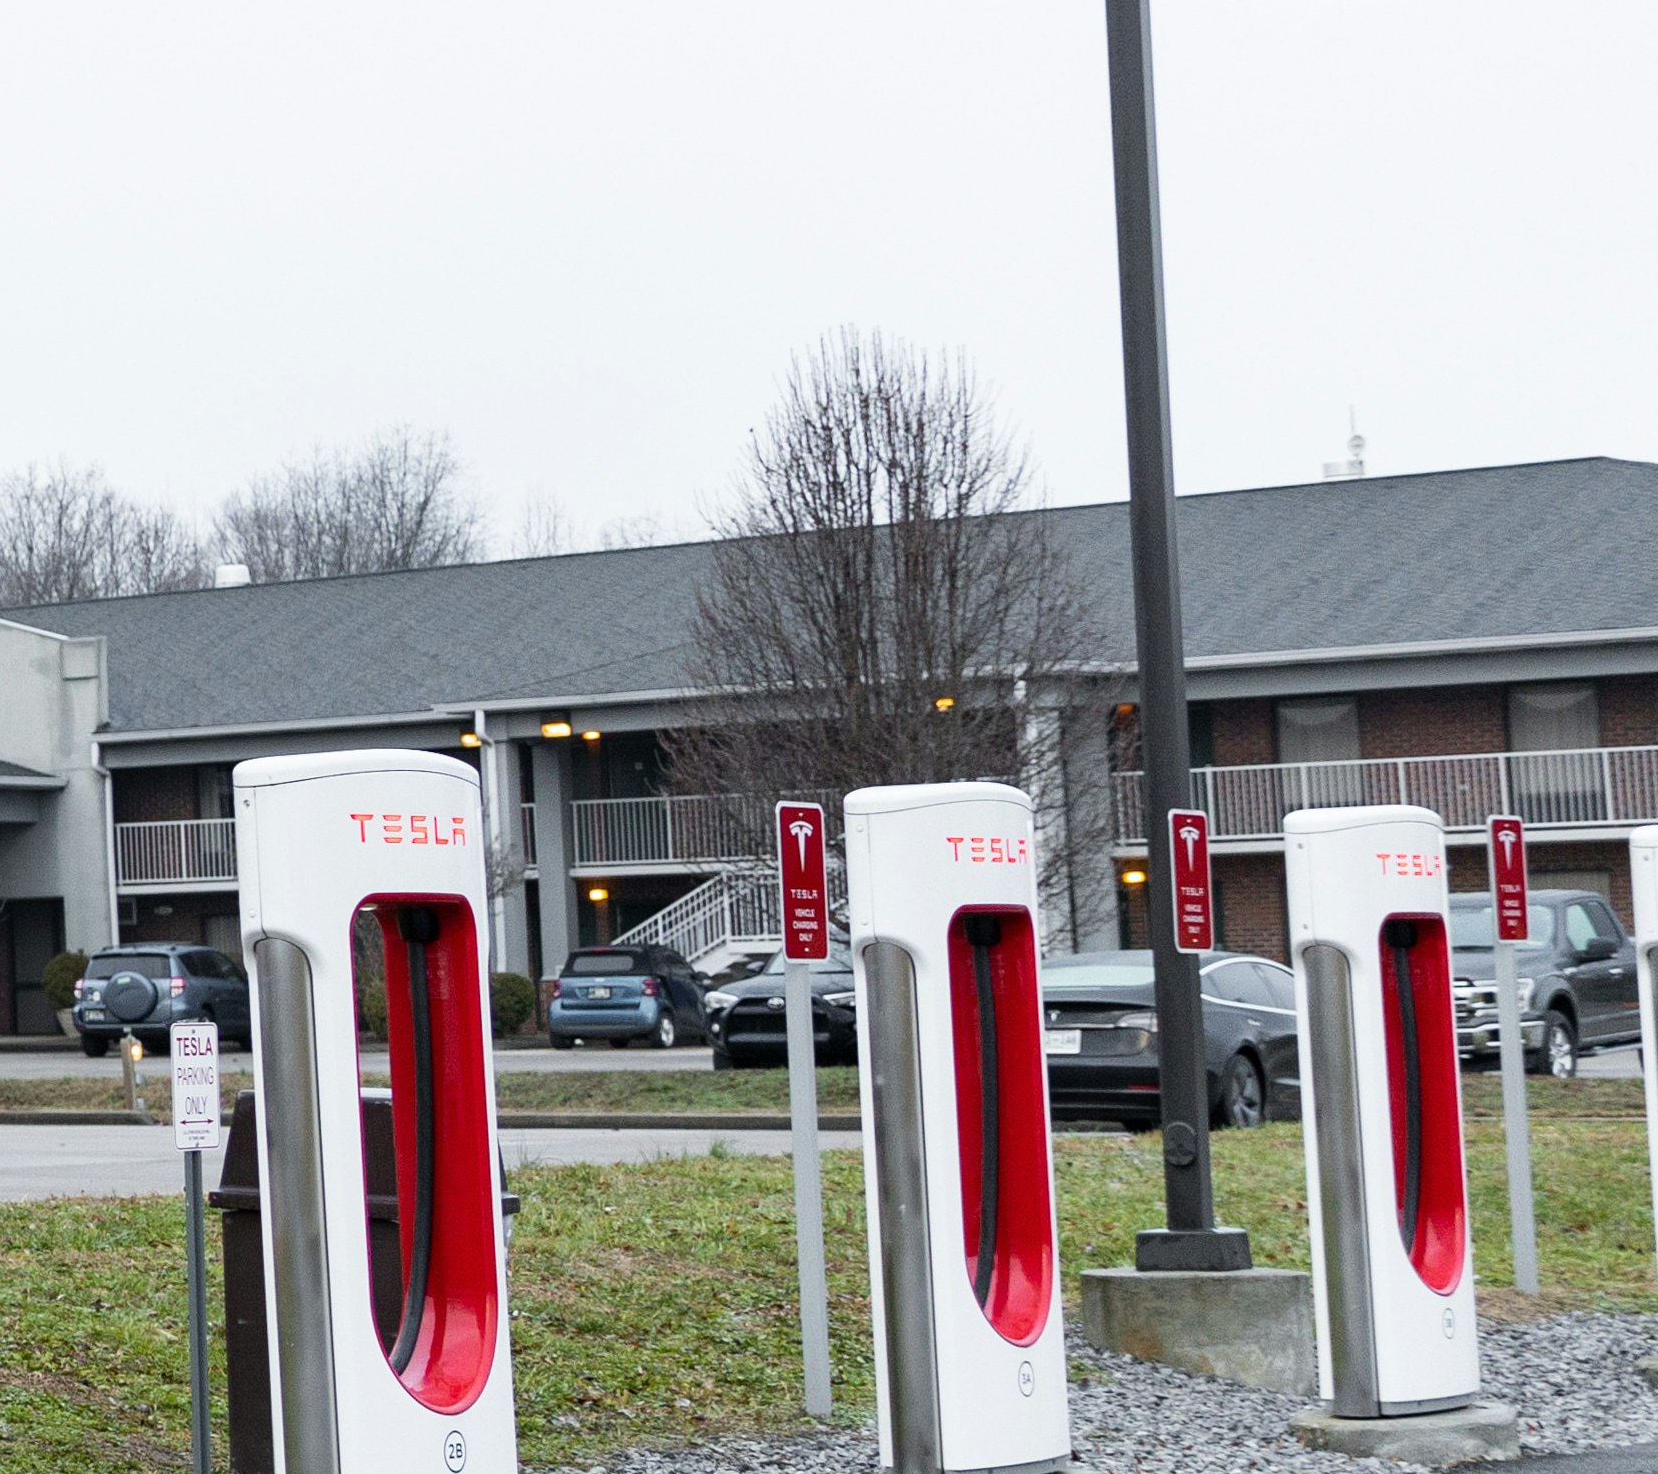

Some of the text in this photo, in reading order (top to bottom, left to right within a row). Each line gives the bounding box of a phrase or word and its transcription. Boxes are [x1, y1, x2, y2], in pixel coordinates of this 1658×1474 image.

[349, 813, 466, 847] TESLA
[946, 837, 1028, 864] TESLA
[1376, 853, 1441, 877] TESLA
[790, 889, 819, 900] TESLA
[176, 1037, 213, 1057] TESLA
[177, 1066, 214, 1086] PARKING
[185, 1096, 207, 1115] ONLY
[448, 1443, 463, 1459] 2B
